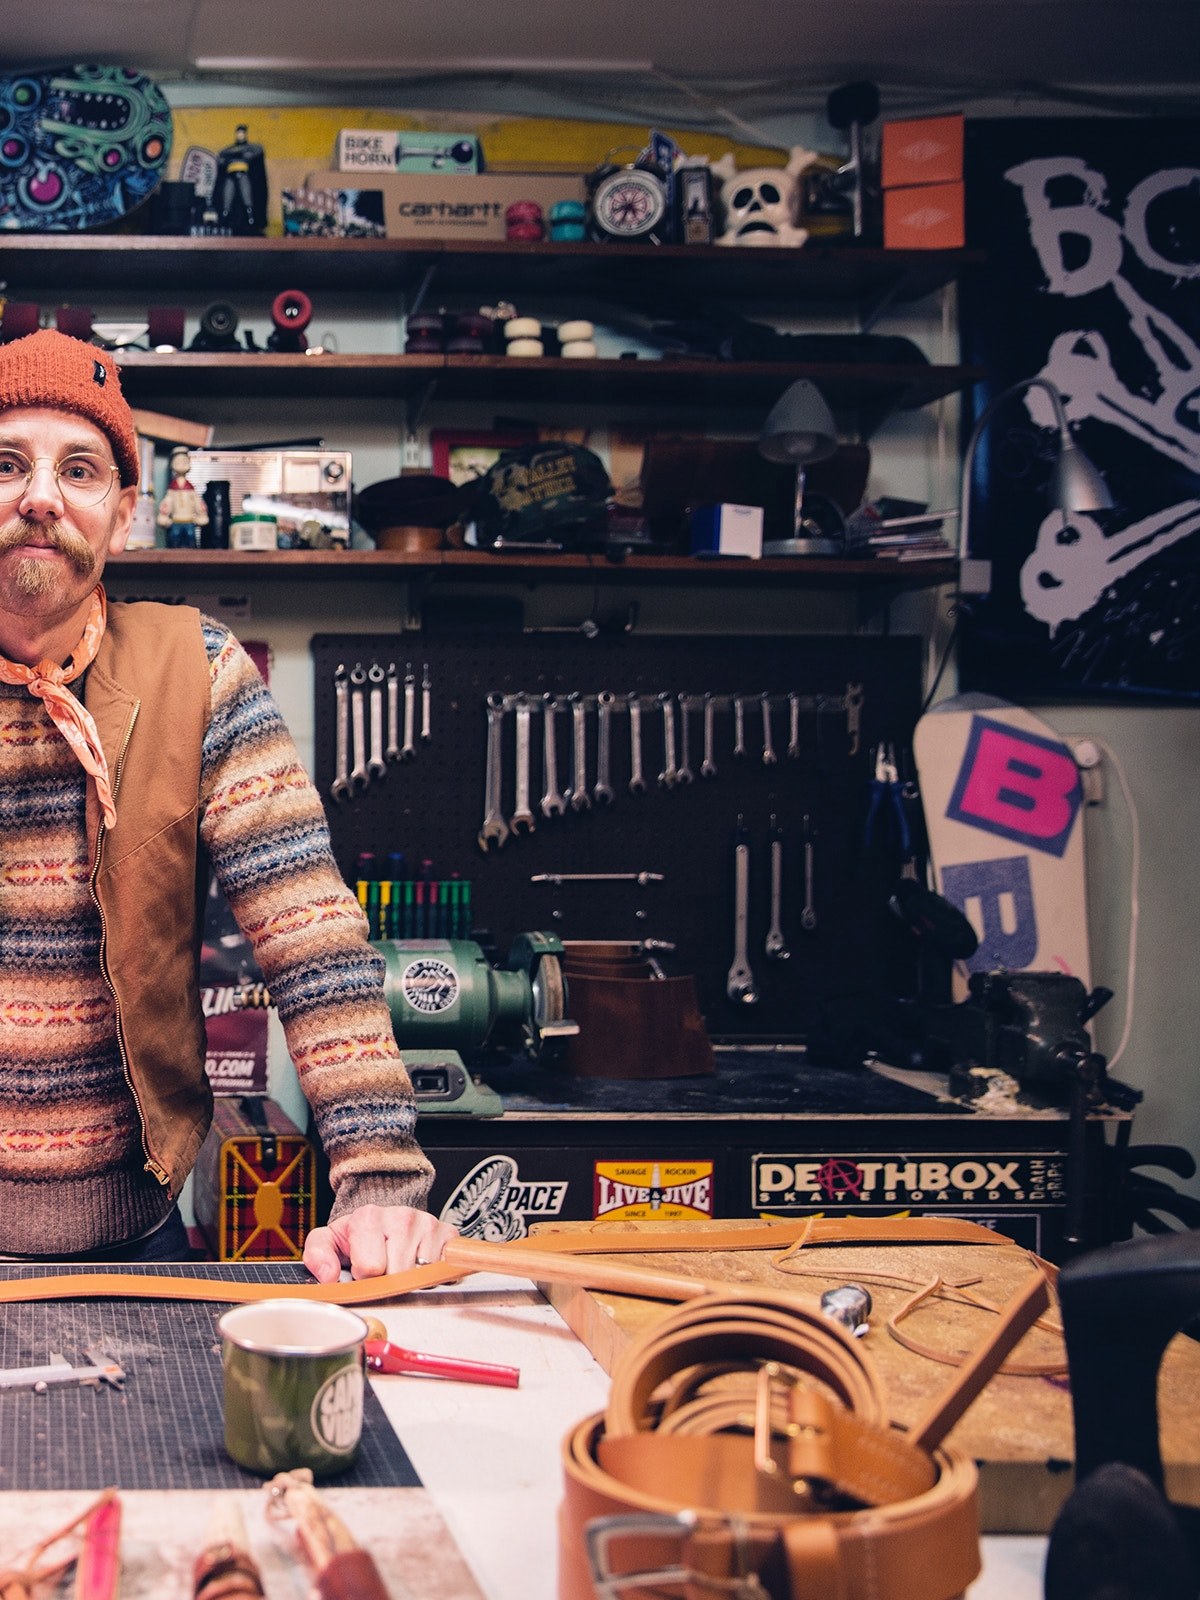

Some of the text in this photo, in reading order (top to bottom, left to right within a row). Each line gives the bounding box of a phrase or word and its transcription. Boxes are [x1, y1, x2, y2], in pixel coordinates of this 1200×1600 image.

[345, 136, 384, 149] BIKE
[345, 152, 393, 166] HORN
[399, 200, 503, 217] carhartt
[204, 1058, 256, 1078] O.COM
[759, 1159, 1022, 1197] DEATHBOX
[504, 1186, 564, 1212] PACE
[598, 1175, 650, 1214] LIVE
[661, 1177, 711, 1212] JIVE
[759, 1190, 1026, 1203] SKATEBOARDS
